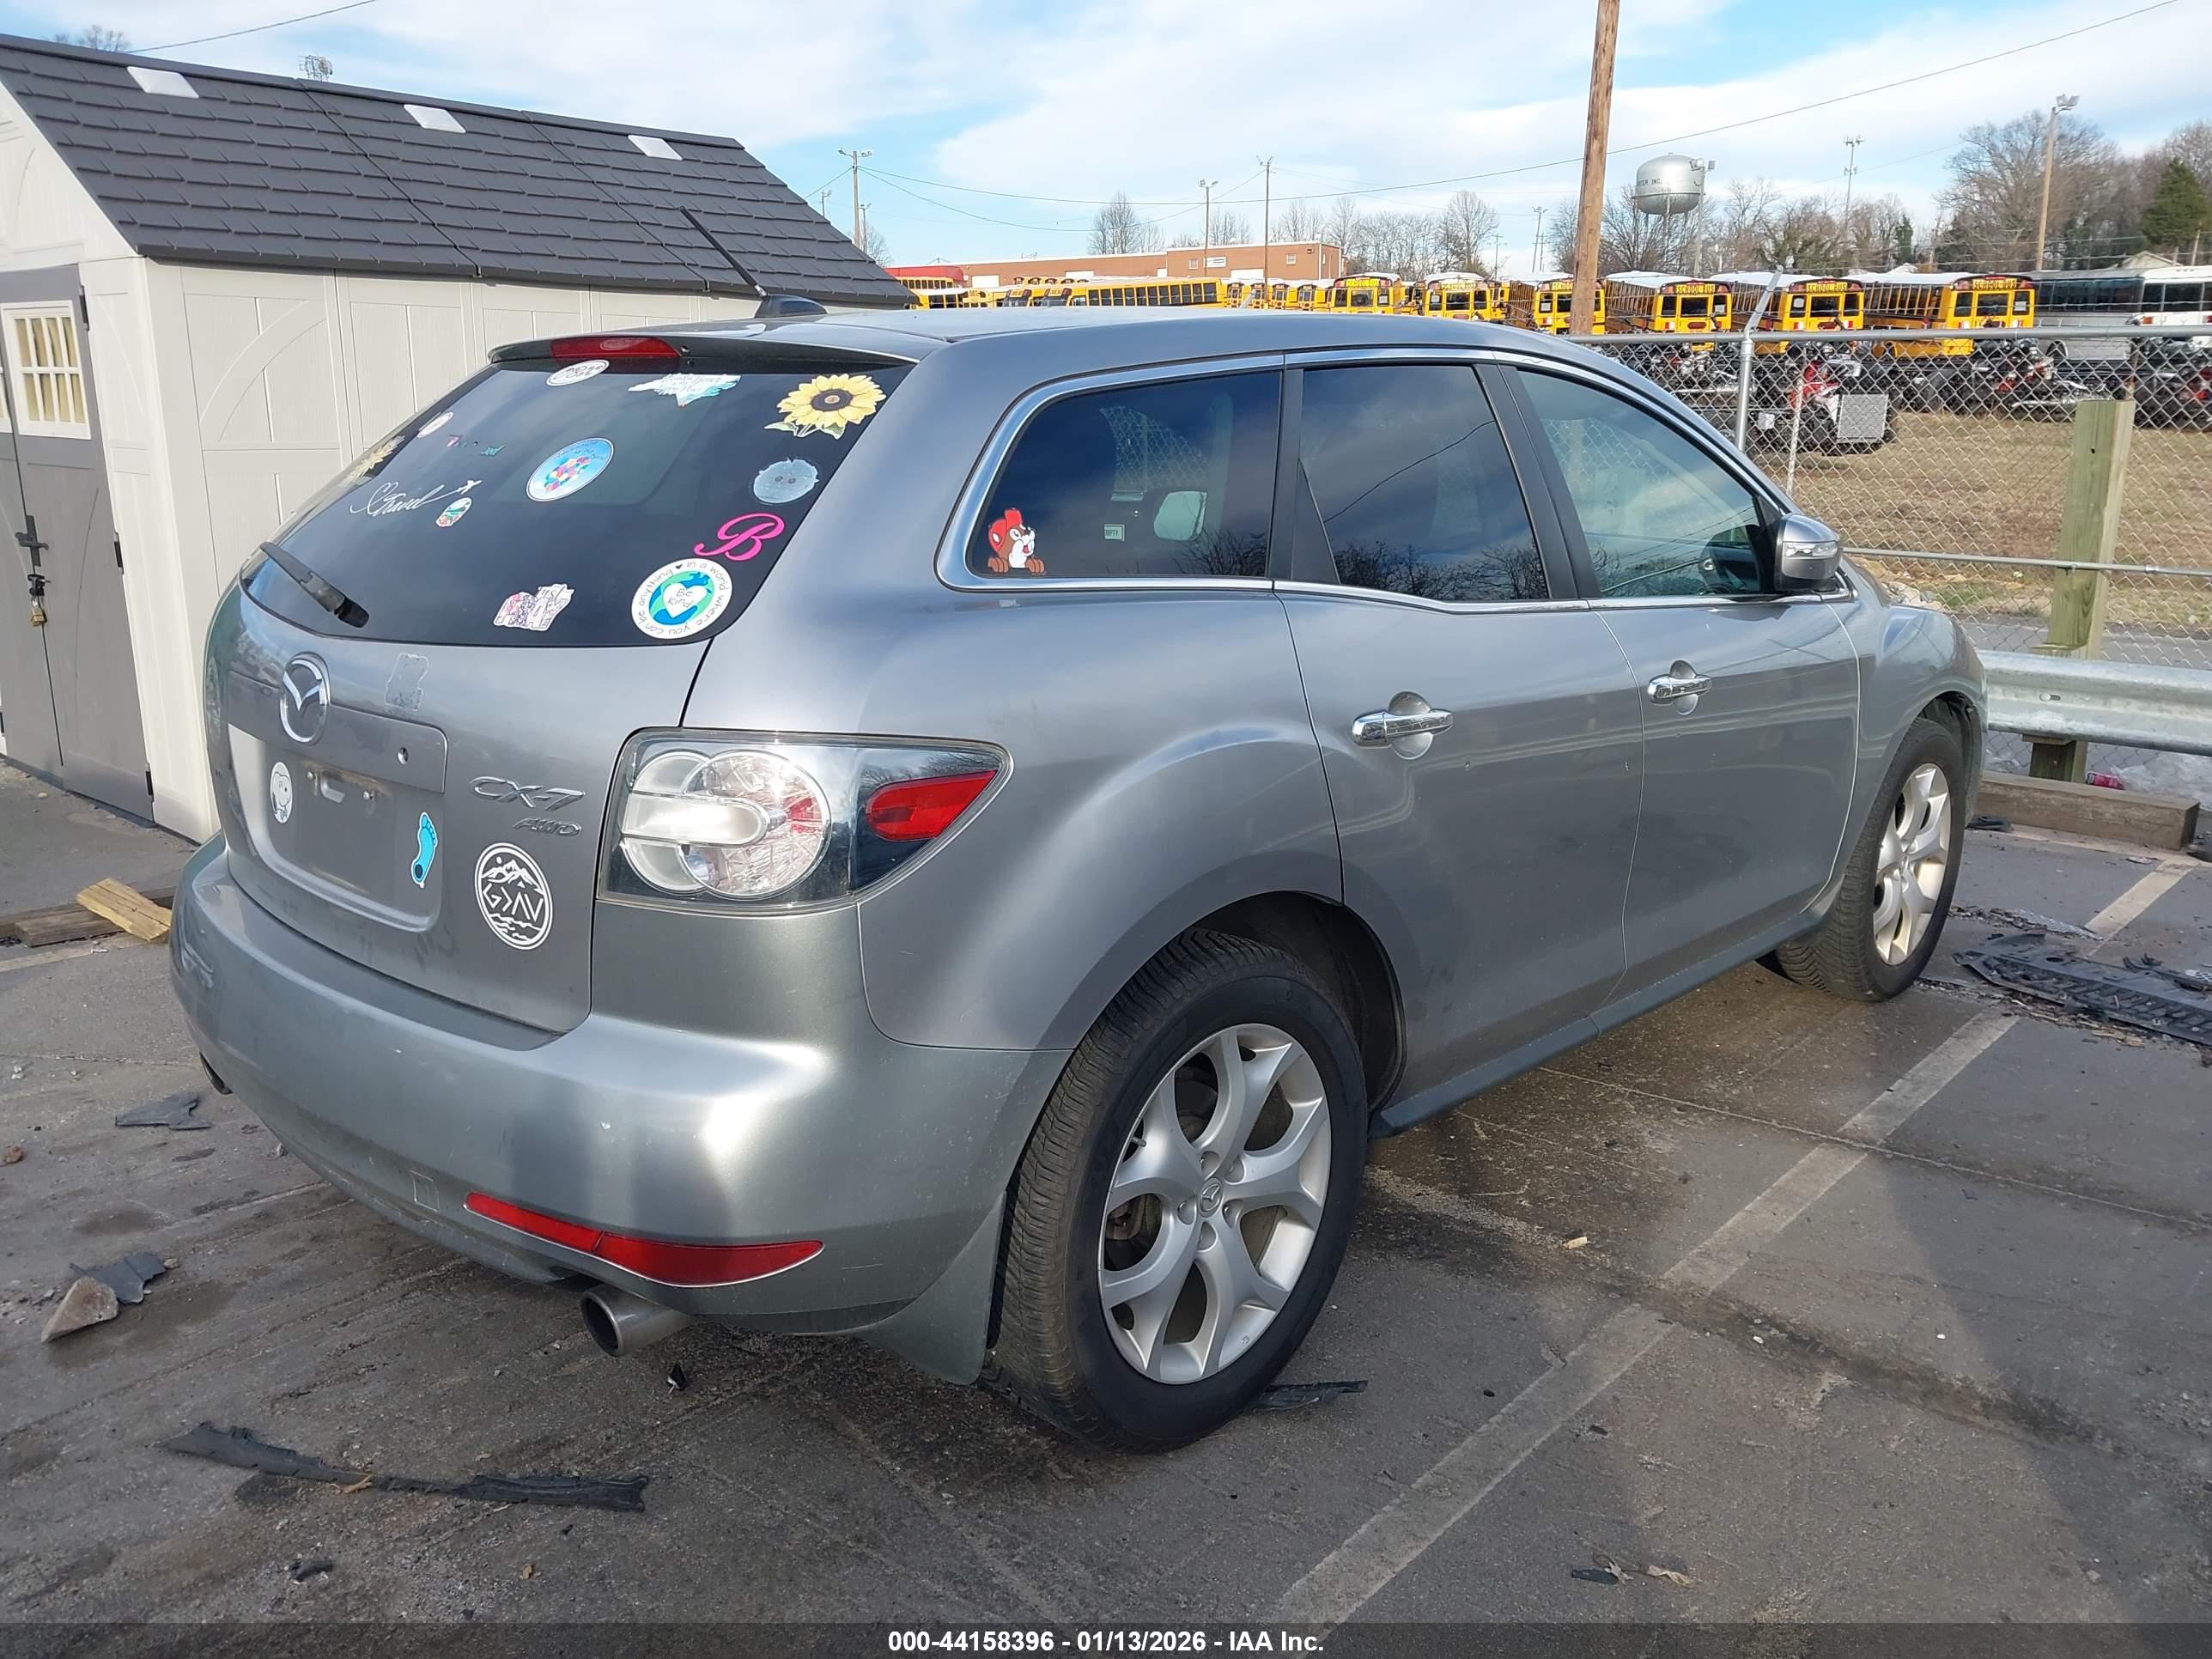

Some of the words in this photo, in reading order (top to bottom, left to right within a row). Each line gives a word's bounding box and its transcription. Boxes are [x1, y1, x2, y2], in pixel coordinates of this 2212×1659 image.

[1677, 284, 1701, 293] SCHOOL
[1702, 283, 1715, 292] BUS
[1808, 283, 1831, 292] SCHOOL
[1833, 283, 1846, 291] BUS
[1974, 280, 2001, 289] SCHOOL
[2002, 279, 2015, 288] BUS
[694, 513, 785, 562] B
[638, 569, 675, 606] anything
[709, 567, 731, 591] world
[696, 594, 725, 627] where
[645, 623, 665, 635] can
[668, 622, 691, 635] you
[470, 775, 586, 811] CX-7
[513, 817, 582, 836] AWD
